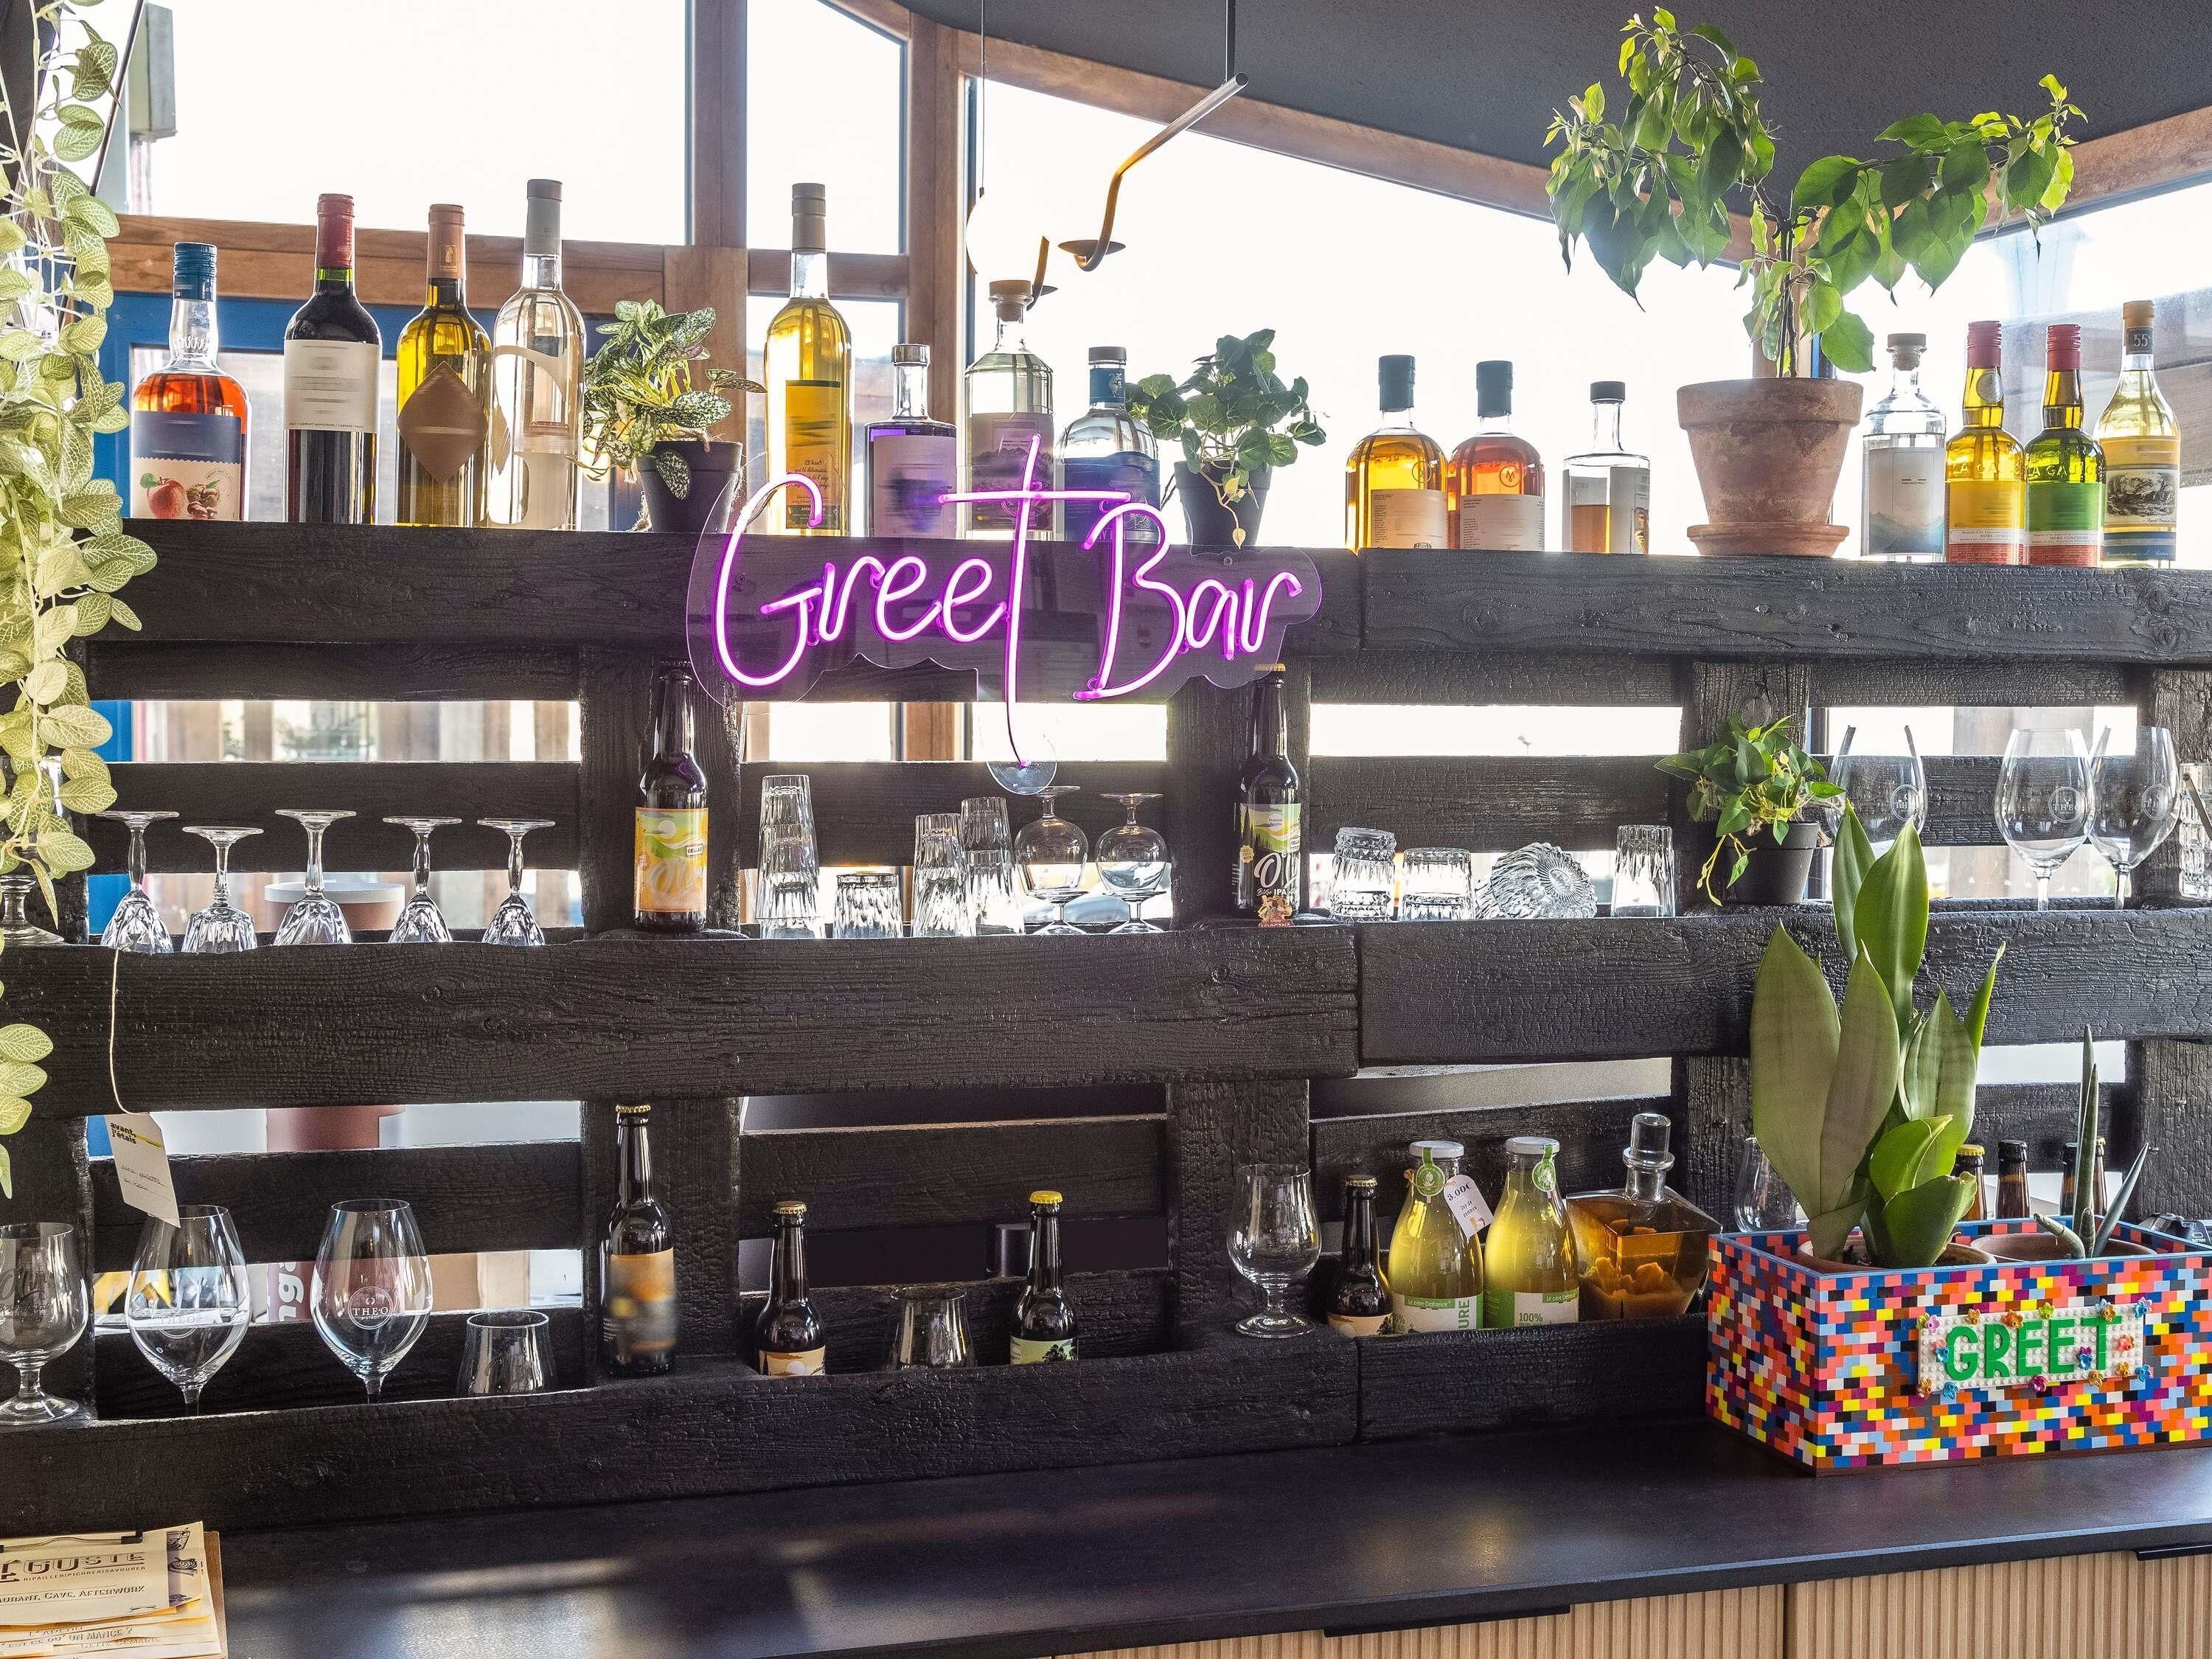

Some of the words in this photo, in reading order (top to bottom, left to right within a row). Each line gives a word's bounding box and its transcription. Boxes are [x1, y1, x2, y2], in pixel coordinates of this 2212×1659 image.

[713, 433, 1133, 768] Greet
[1072, 502, 1304, 702] Bar
[1518, 1312, 1543, 1322] 100%
[1945, 1315, 2123, 1382] GREET
[78, 1585, 145, 1597] AFTERWORK
